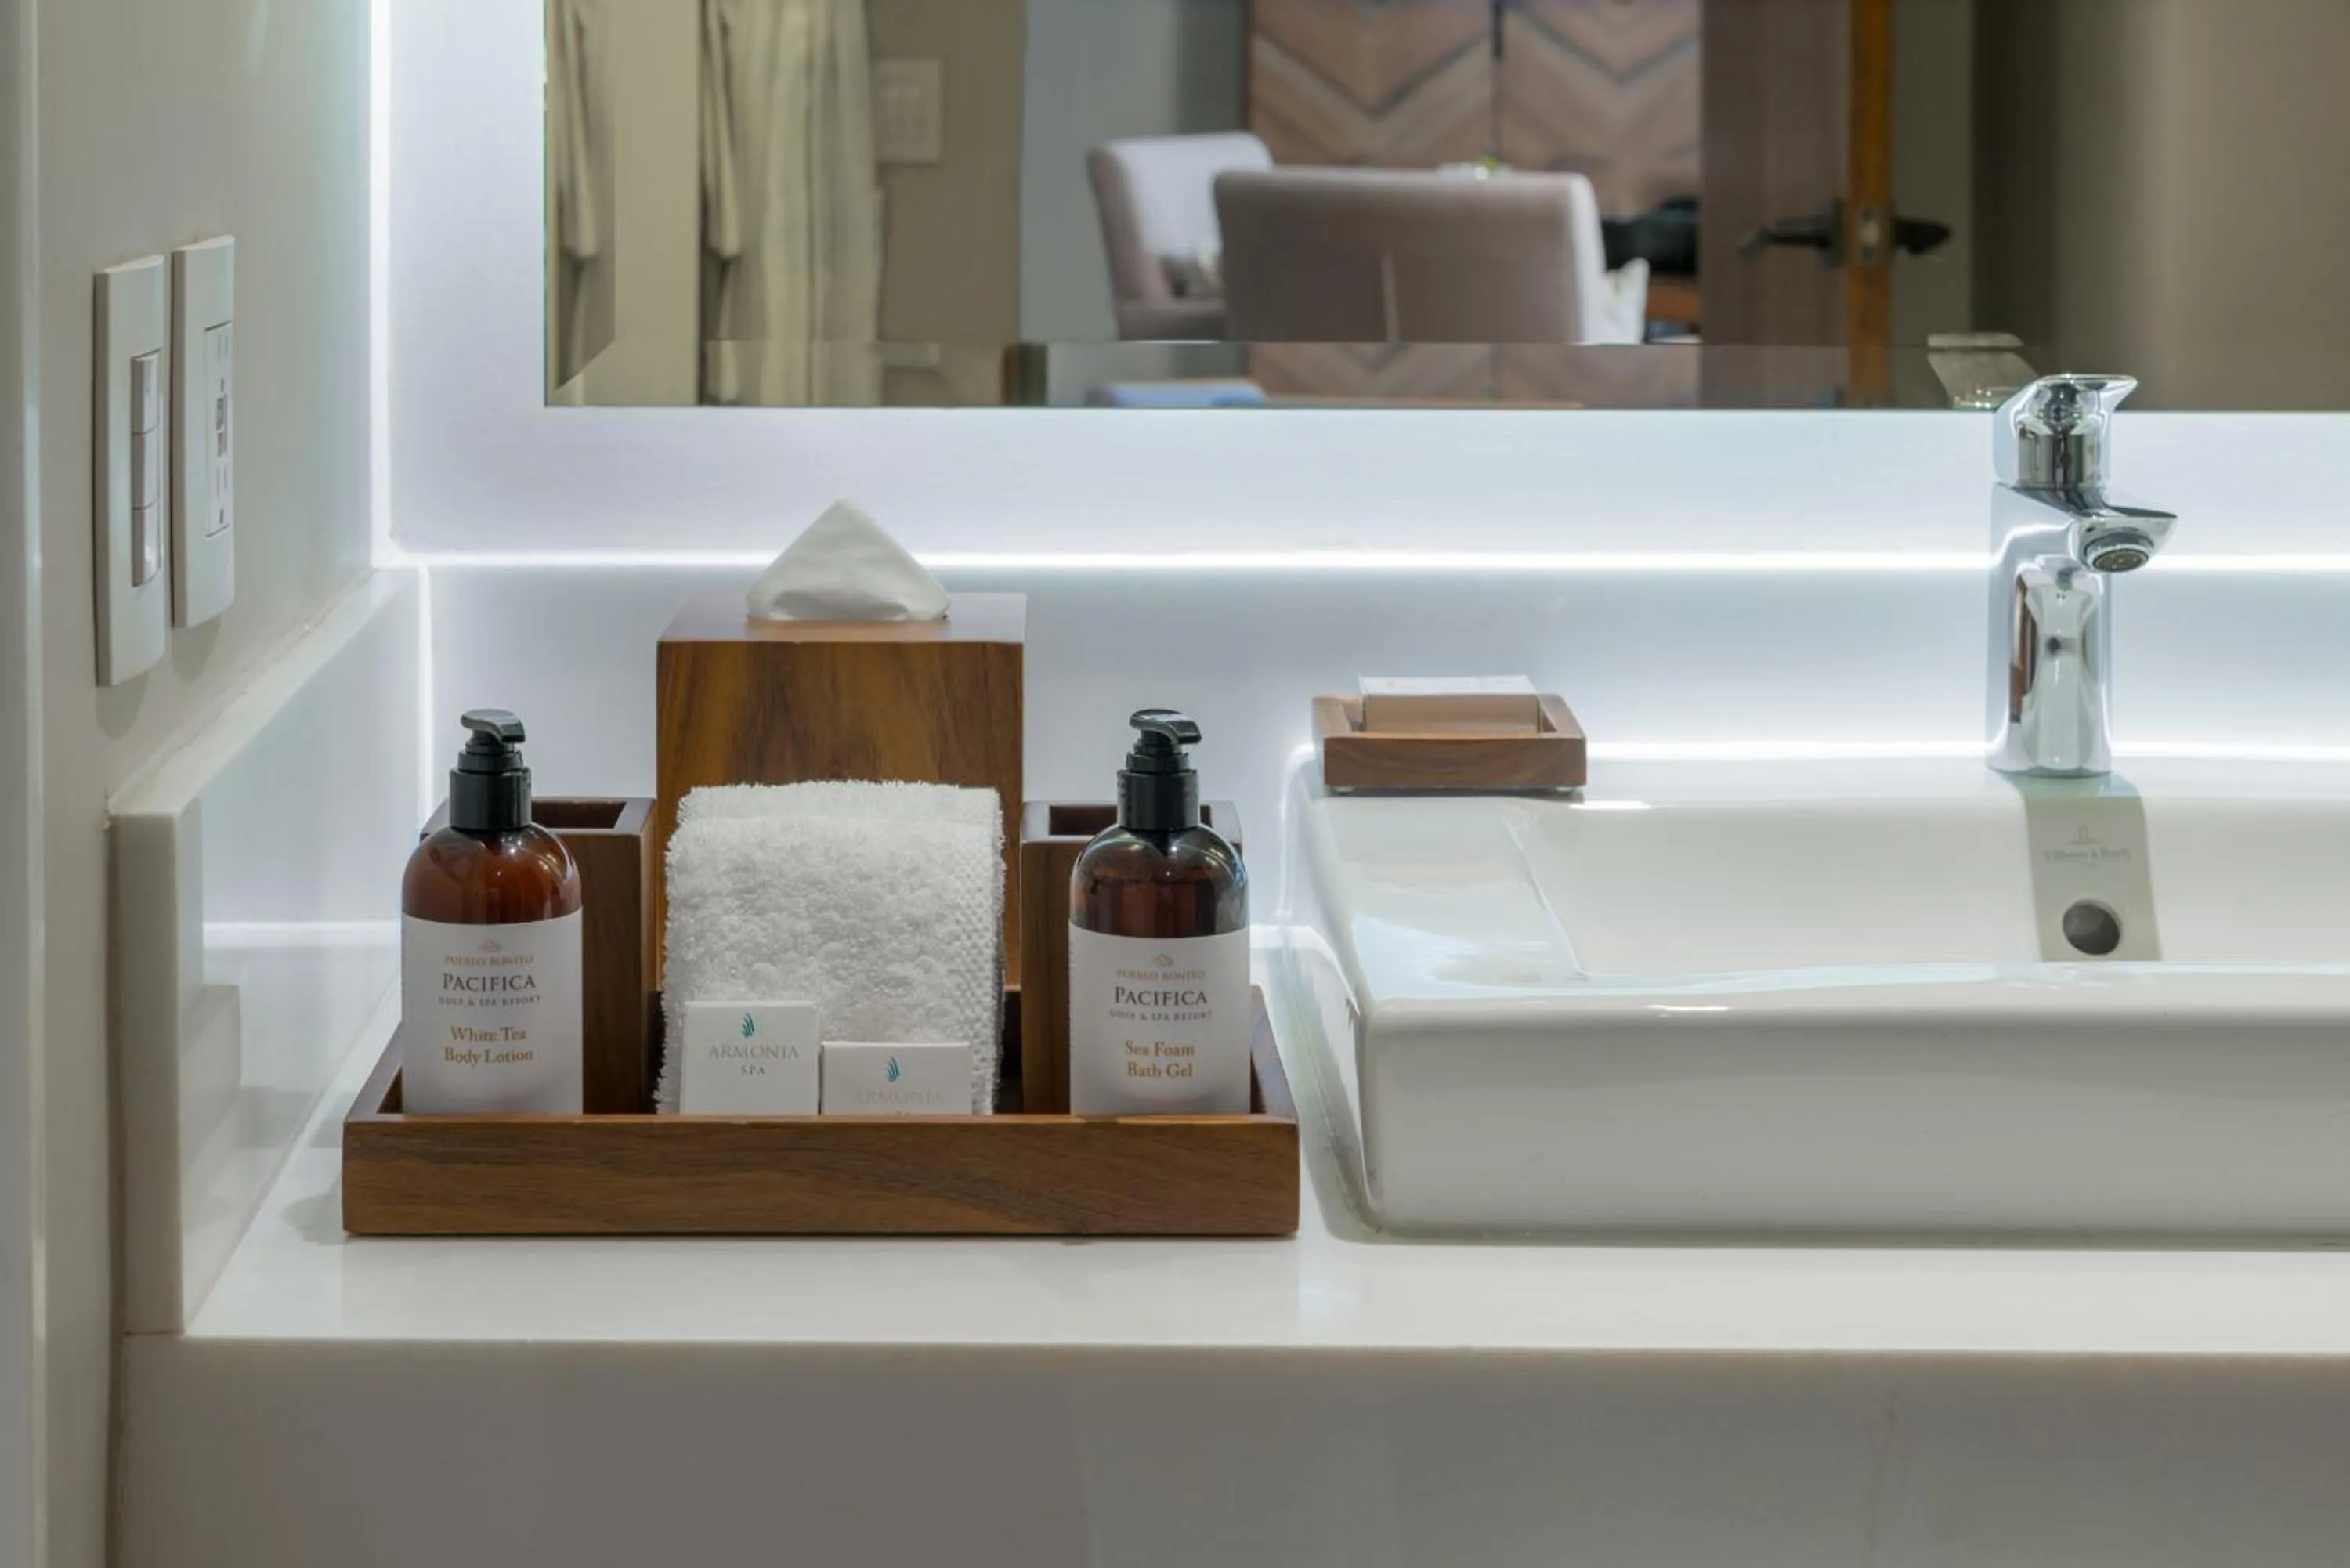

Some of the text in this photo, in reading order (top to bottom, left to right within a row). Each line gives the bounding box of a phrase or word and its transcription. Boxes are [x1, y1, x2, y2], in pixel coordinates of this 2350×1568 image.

[443, 973, 536, 992] PACIFICA
[1115, 985, 1208, 1006] PACIFICA
[450, 1025, 527, 1042] White Tea
[444, 1046, 533, 1065] Body Lotion
[708, 1043, 799, 1060] ARMONIA
[1125, 1040, 1195, 1057] Sea Foam
[739, 1064, 765, 1076] SPA
[1127, 1061, 1193, 1078] Bath Gel
